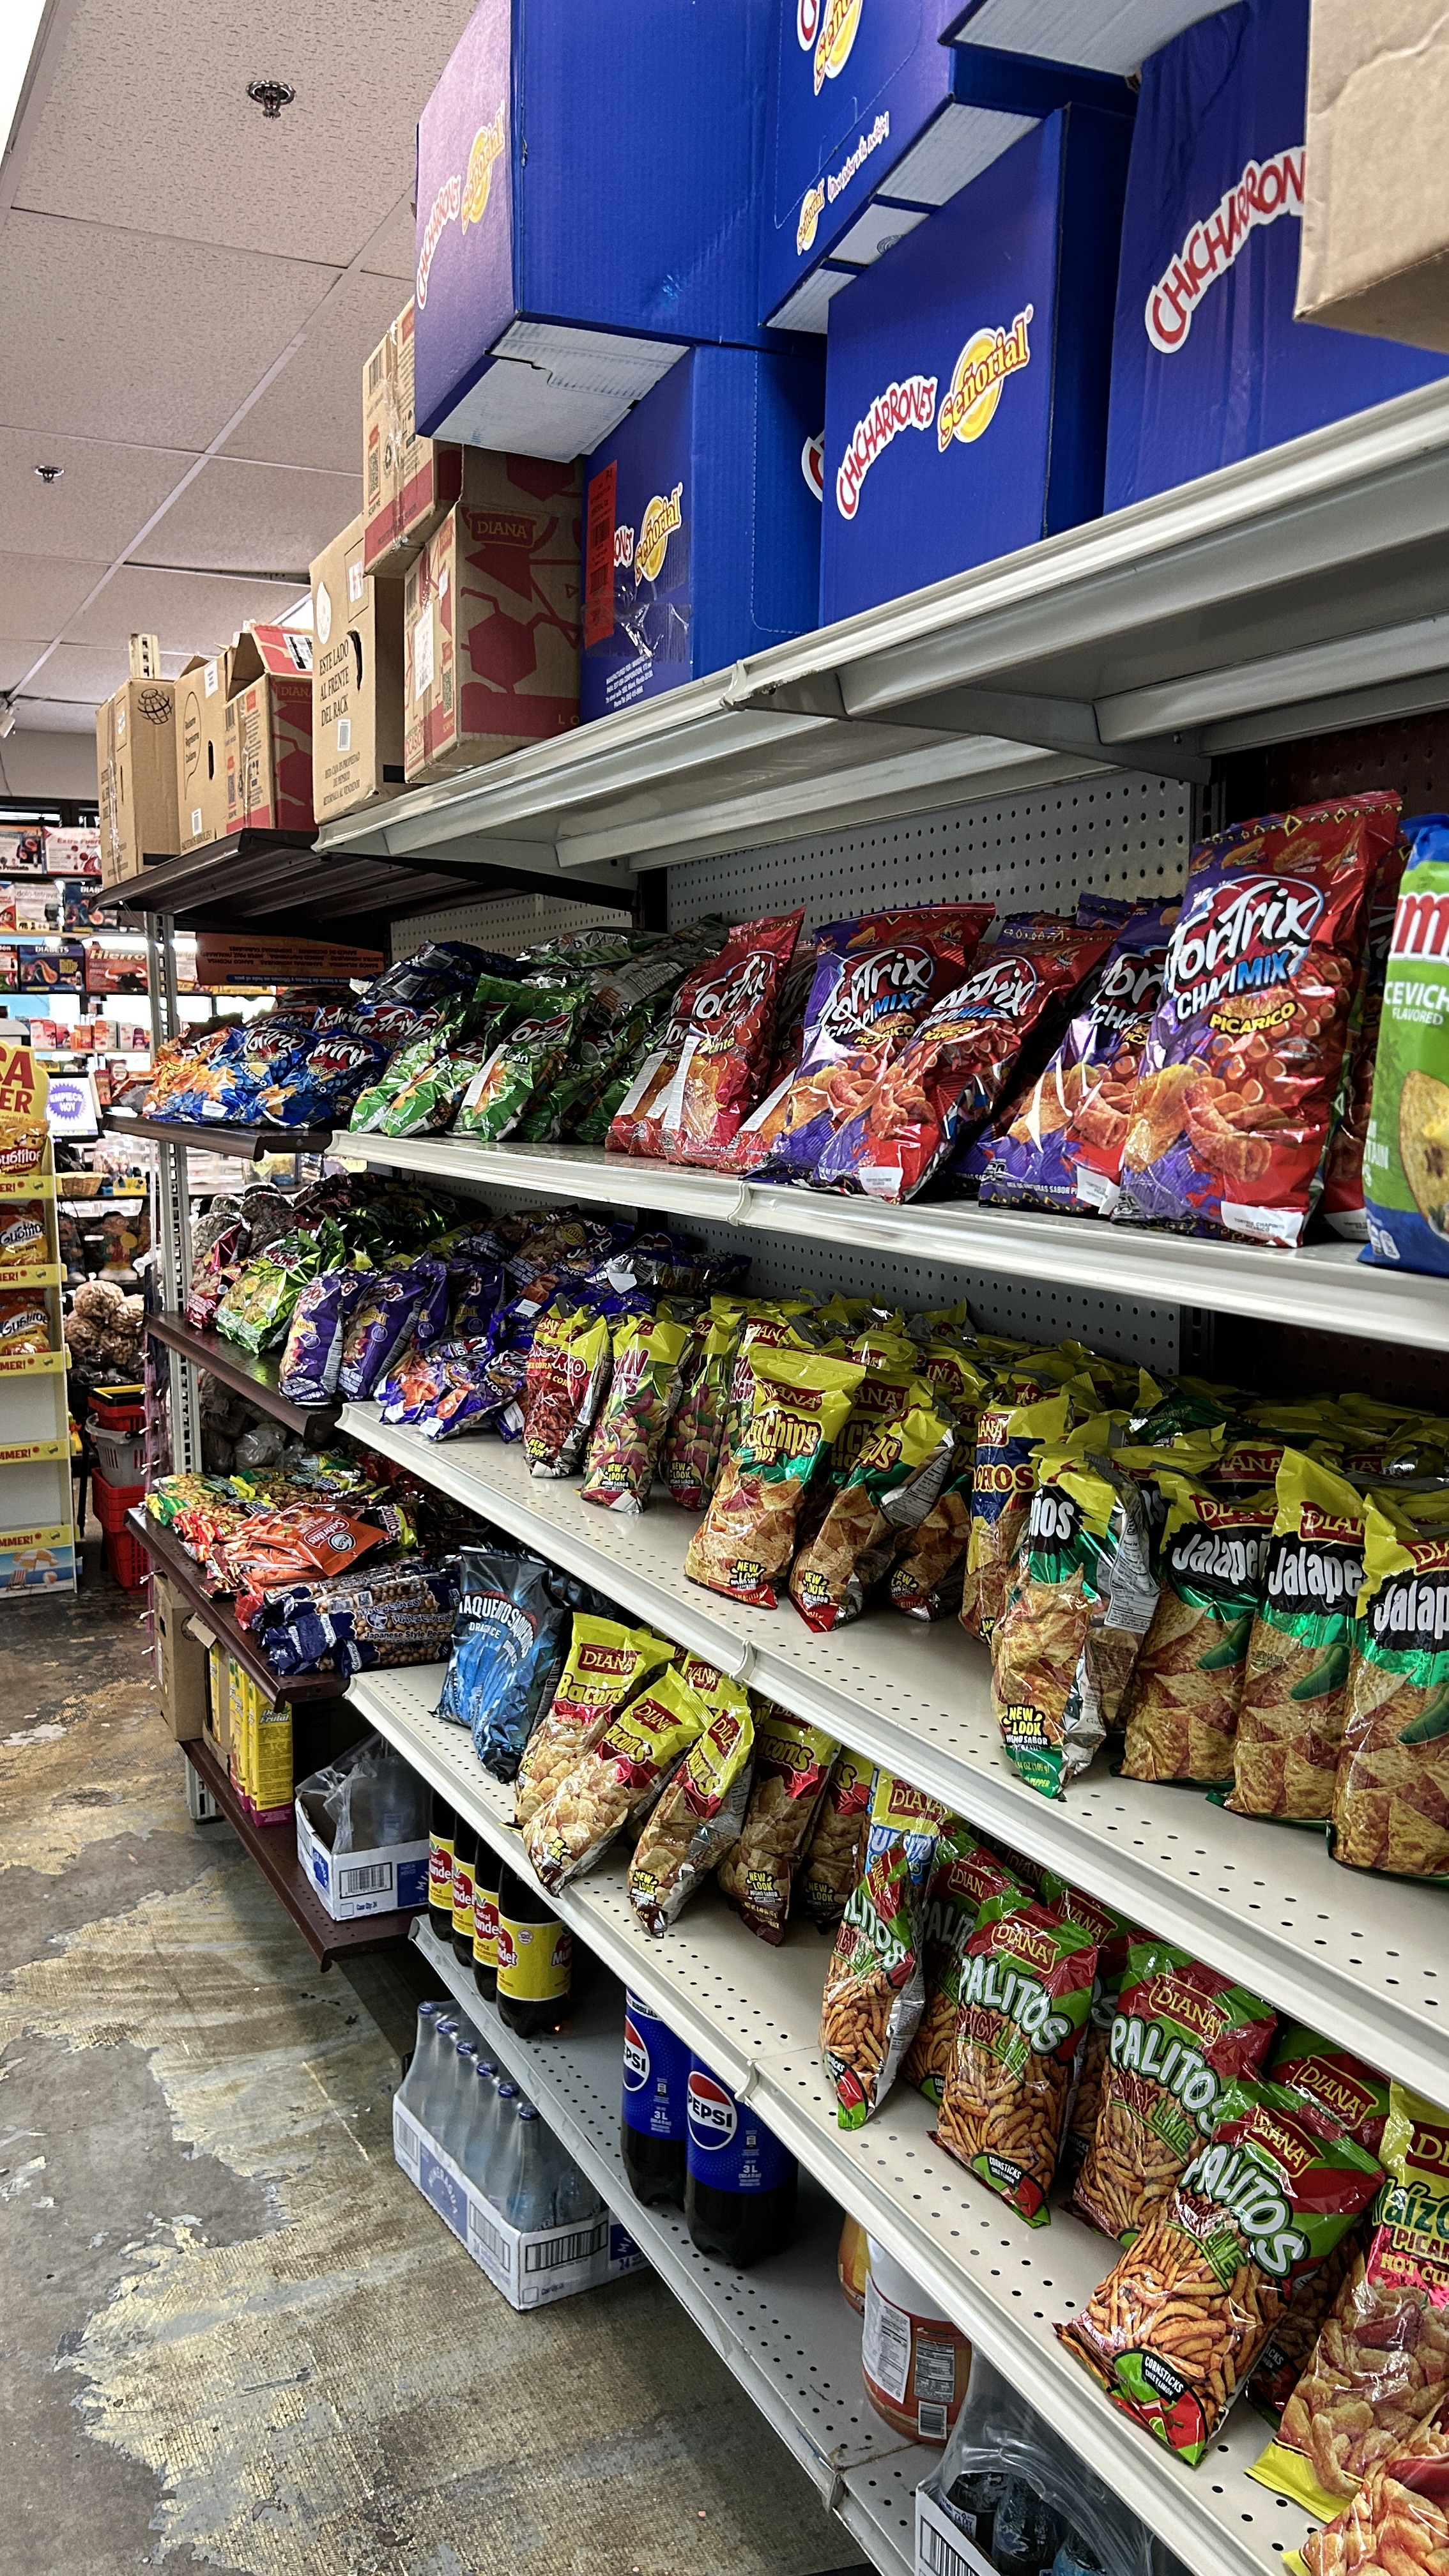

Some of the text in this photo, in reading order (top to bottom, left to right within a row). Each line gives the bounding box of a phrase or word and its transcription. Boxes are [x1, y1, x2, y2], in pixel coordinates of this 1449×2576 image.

[1151, 150, 1305, 345] CHICHARRON
[839, 378, 935, 516] CHICHARRONES
[939, 319, 1030, 449] Señorial
[477, 521, 526, 539] DIANA
[636, 491, 681, 584] Señorial
[320, 639, 348, 676] ESTE LADO
[281, 687, 312, 698] DIAN
[320, 666, 349, 702] AL FRENTE
[322, 694, 348, 726] DEL RACK
[1167, 880, 1317, 992] TorTrix
[90, 949, 146, 961] Hierro
[818, 949, 930, 1025] TorTrix
[1175, 951, 1291, 1021] CHAPIMIX
[1384, 980, 1449, 1011] CEVICH
[1209, 1001, 1297, 1034] PICARICO
[1392, 1008, 1445, 1025] FLAVORED
[1049, 1186, 1070, 1194] SABOR
[755, 1447, 776, 1462] HOT
[308, 1521, 346, 1544] Sabritas
[1305, 1512, 1365, 1535] DIAN
[737, 1561, 758, 1573] NEW
[1268, 1547, 1363, 1603] Jalape
[1374, 1580, 1449, 1640] Jalap
[365, 1630, 451, 1640] Japanese Style Peanu
[582, 1650, 636, 1672] DIANA
[636, 1705, 673, 1732] DIANA
[1009, 1706, 1033, 1721] NEW
[1012, 1721, 1041, 1736] LOOK
[1023, 1736, 1048, 1745] SABOR
[749, 1872, 765, 1883] NEW
[753, 1882, 772, 1891] LOOK
[808, 1882, 827, 1893] NEW
[954, 1867, 985, 1899] DIAN
[812, 1892, 834, 1903] LOOK
[997, 1922, 1048, 1962] DIANA
[959, 1956, 1069, 2048] PALITOS
[1155, 1985, 1218, 2034] DIANA
[625, 2048, 647, 2073] PSI
[1300, 2066, 1361, 2119] DIANA
[1152, 2098, 1197, 2151] LIME
[743, 2165, 750, 2174] 3
[1381, 2254, 1418, 2277] HOT
[1144, 2356, 1184, 2393] CORNSTICKS
